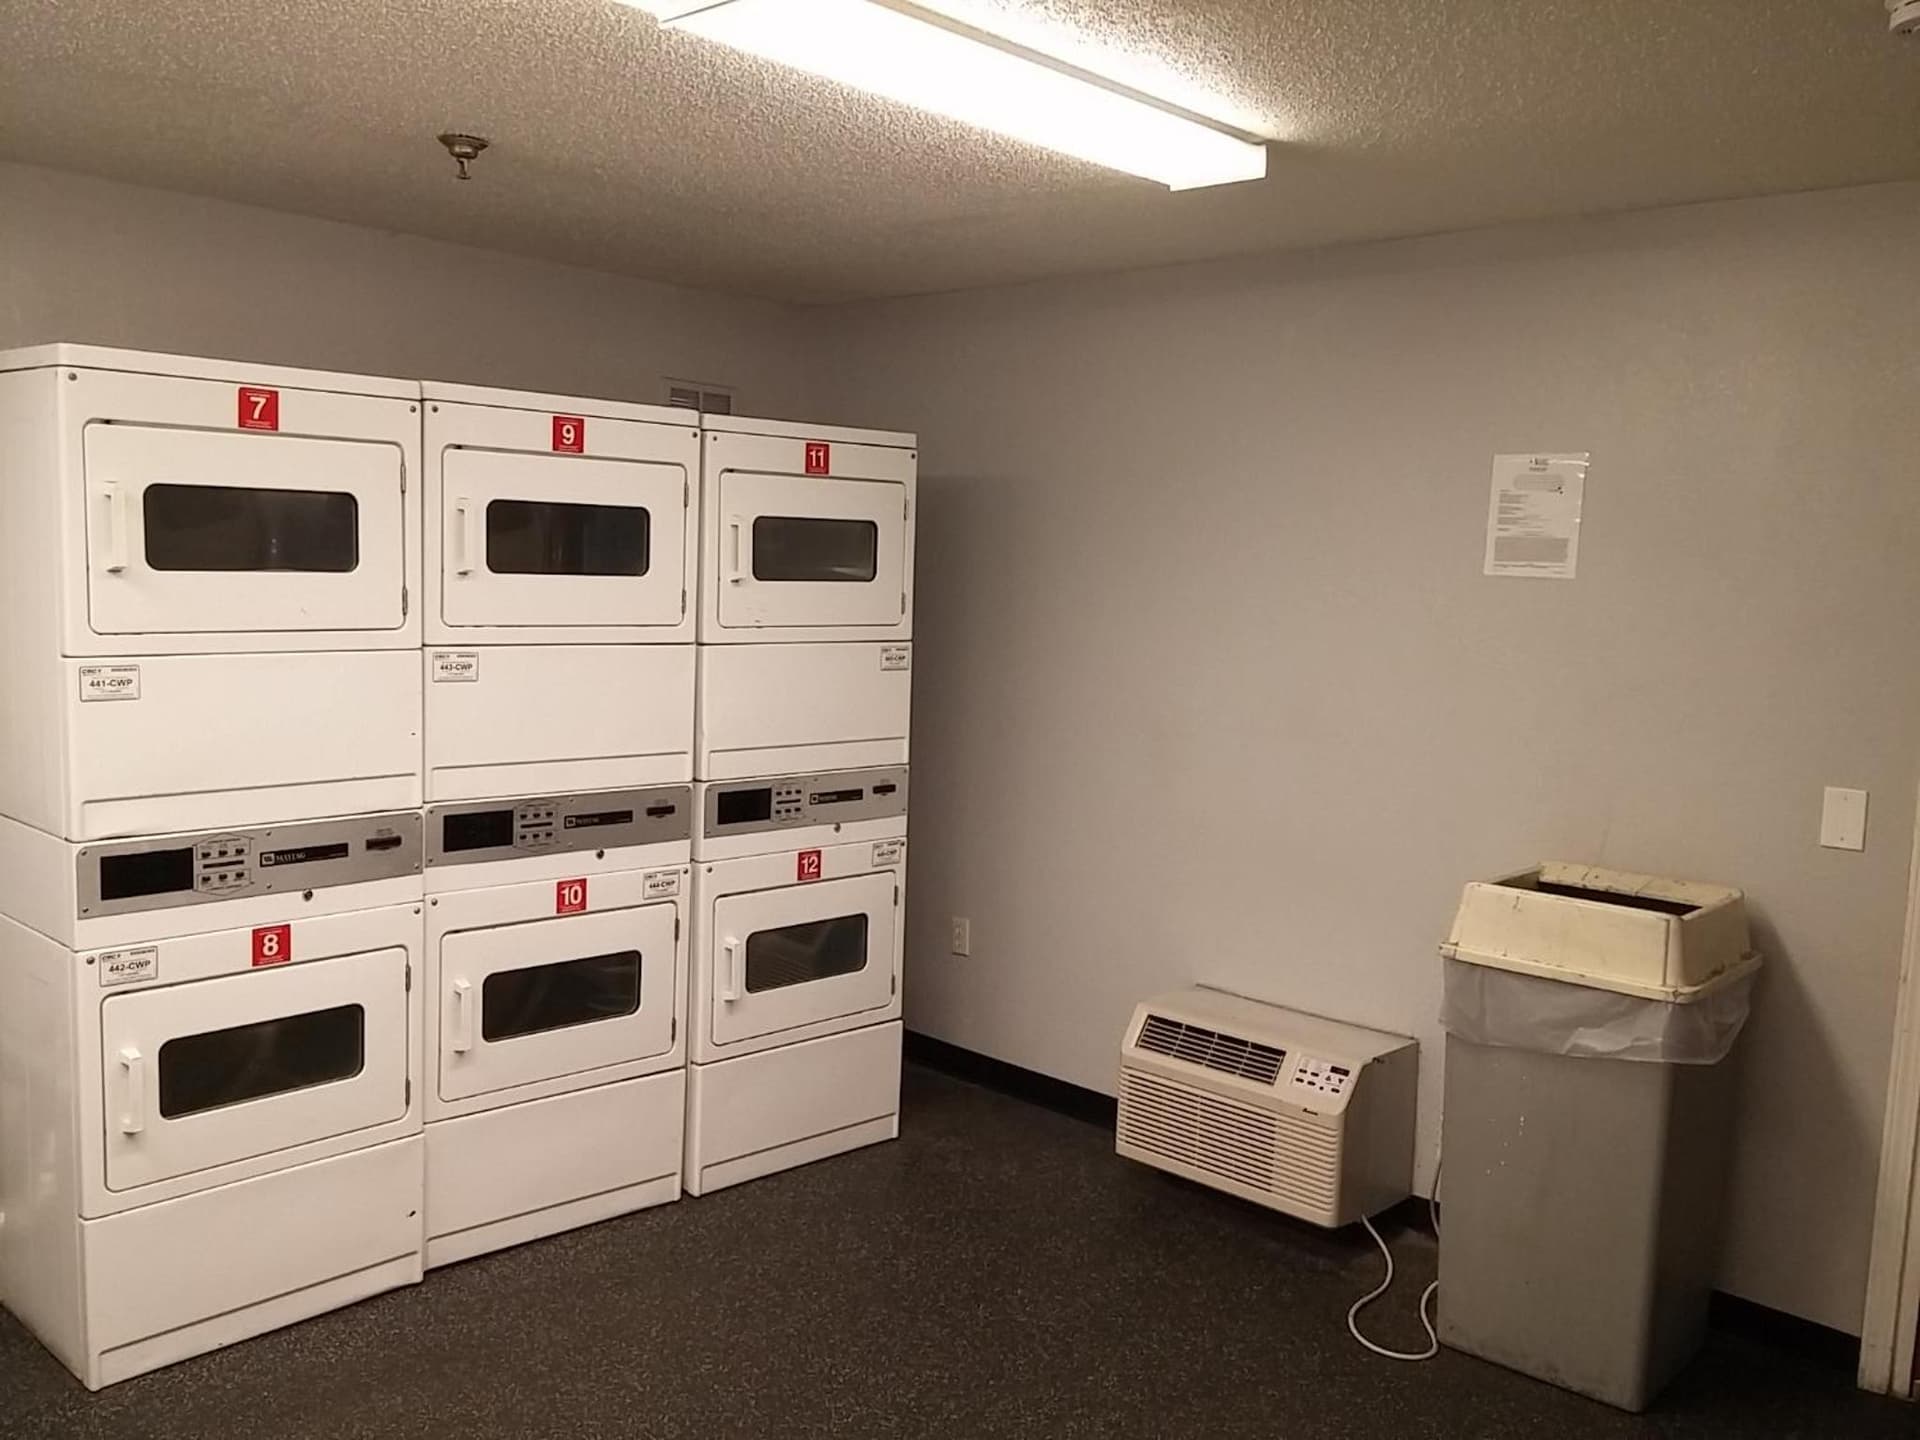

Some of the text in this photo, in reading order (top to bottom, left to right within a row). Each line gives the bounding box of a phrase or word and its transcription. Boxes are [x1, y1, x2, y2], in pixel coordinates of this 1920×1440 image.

[249, 397, 267, 420] 7
[562, 424, 575, 445] 9
[809, 450, 824, 468] 11
[89, 678, 133, 687] 441-CWP
[801, 856, 819, 874] 12
[561, 885, 582, 906] 10
[262, 934, 279, 955] 8
[108, 960, 151, 972] 442-CWP
